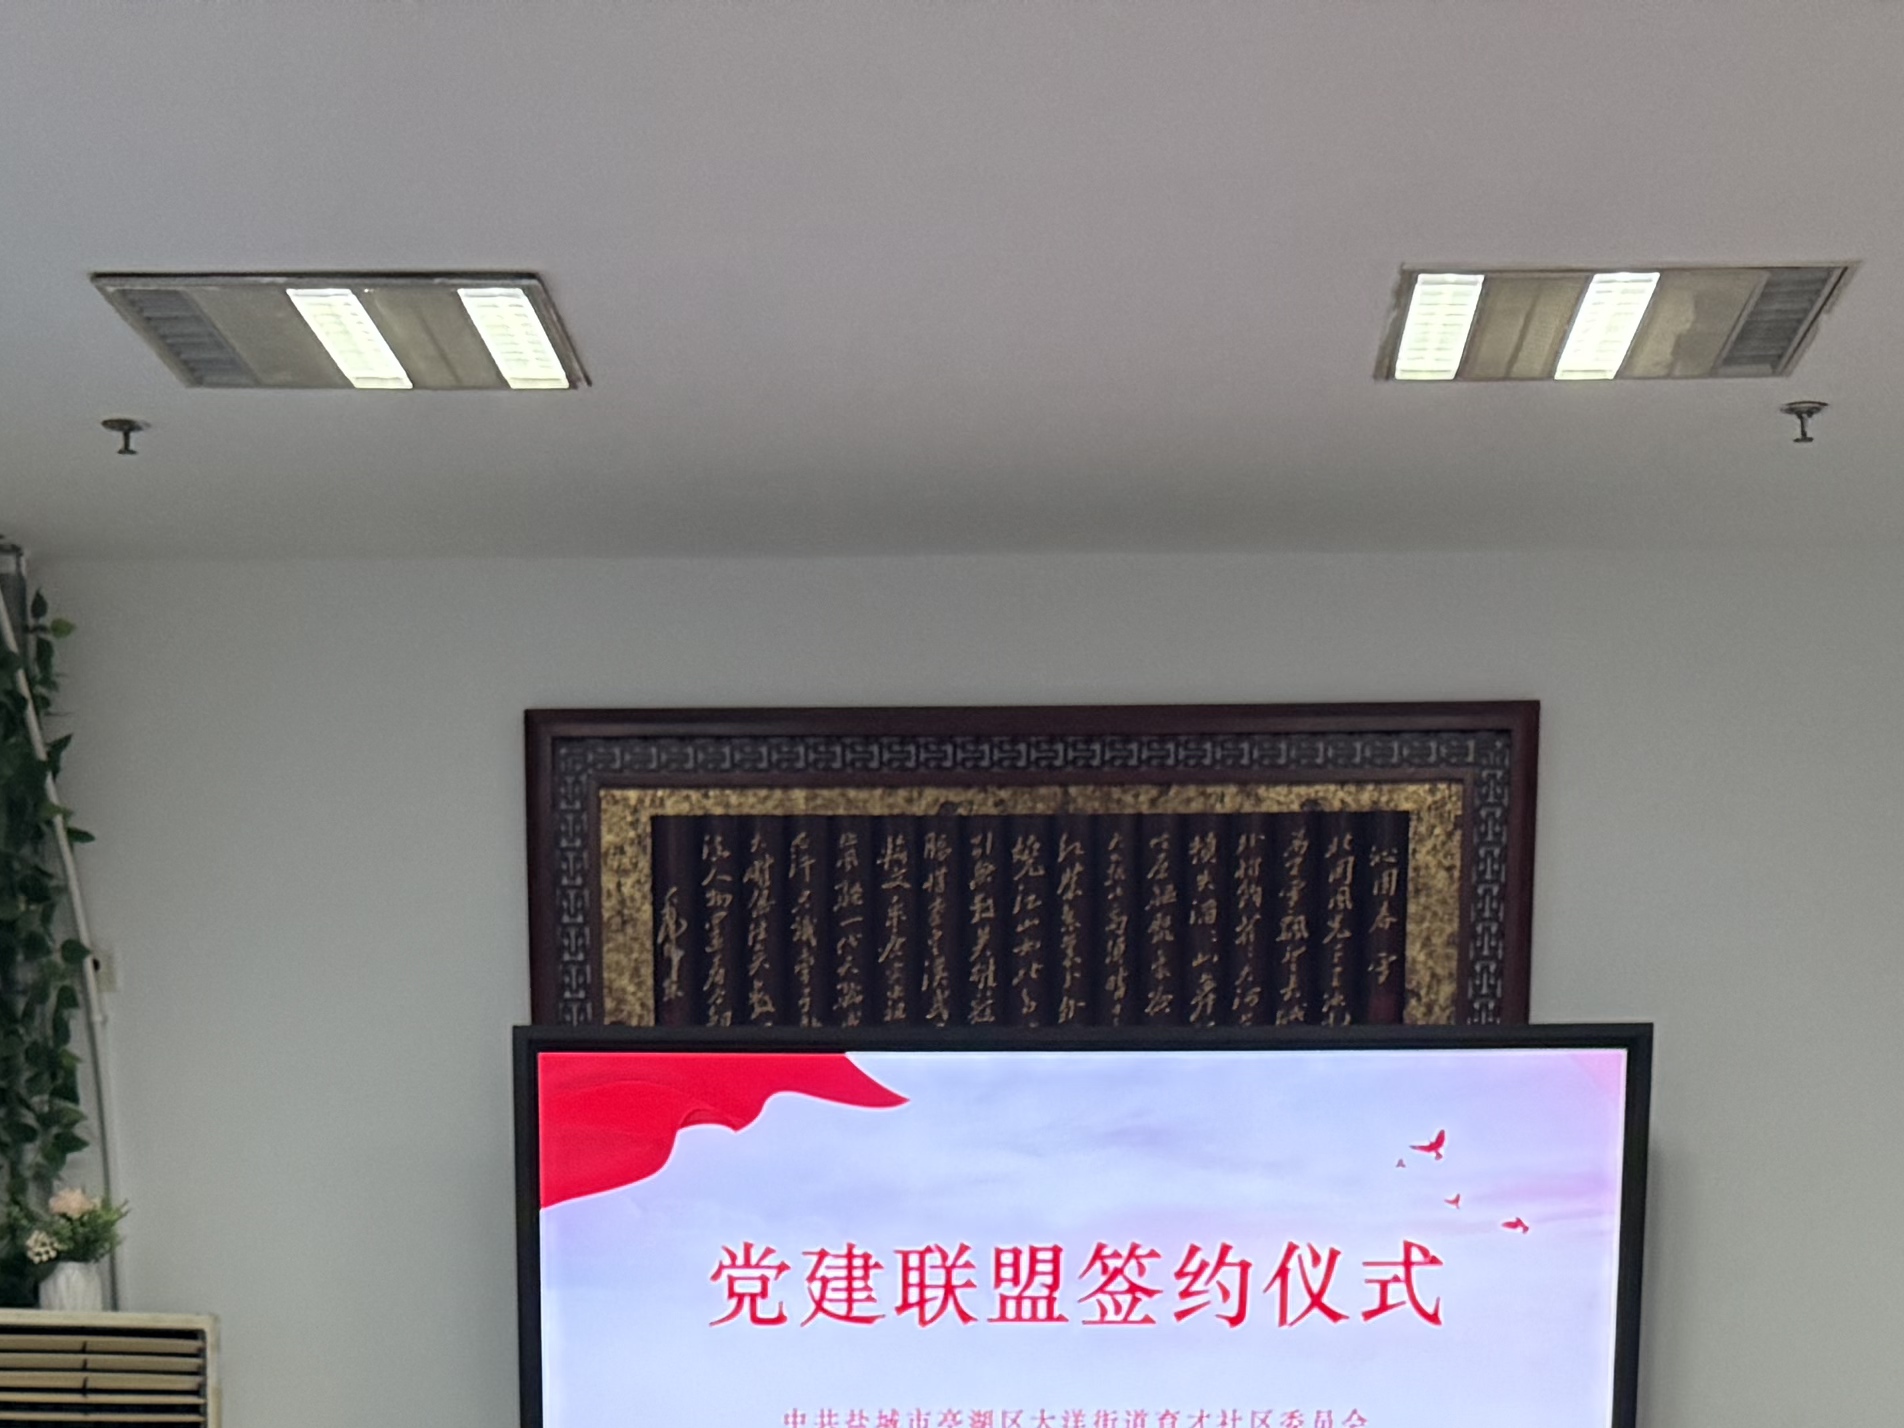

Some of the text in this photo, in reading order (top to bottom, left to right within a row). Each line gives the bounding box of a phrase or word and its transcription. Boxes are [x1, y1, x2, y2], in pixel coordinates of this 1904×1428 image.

[709, 1238, 1446, 1329] 党建联盟签约仪式
